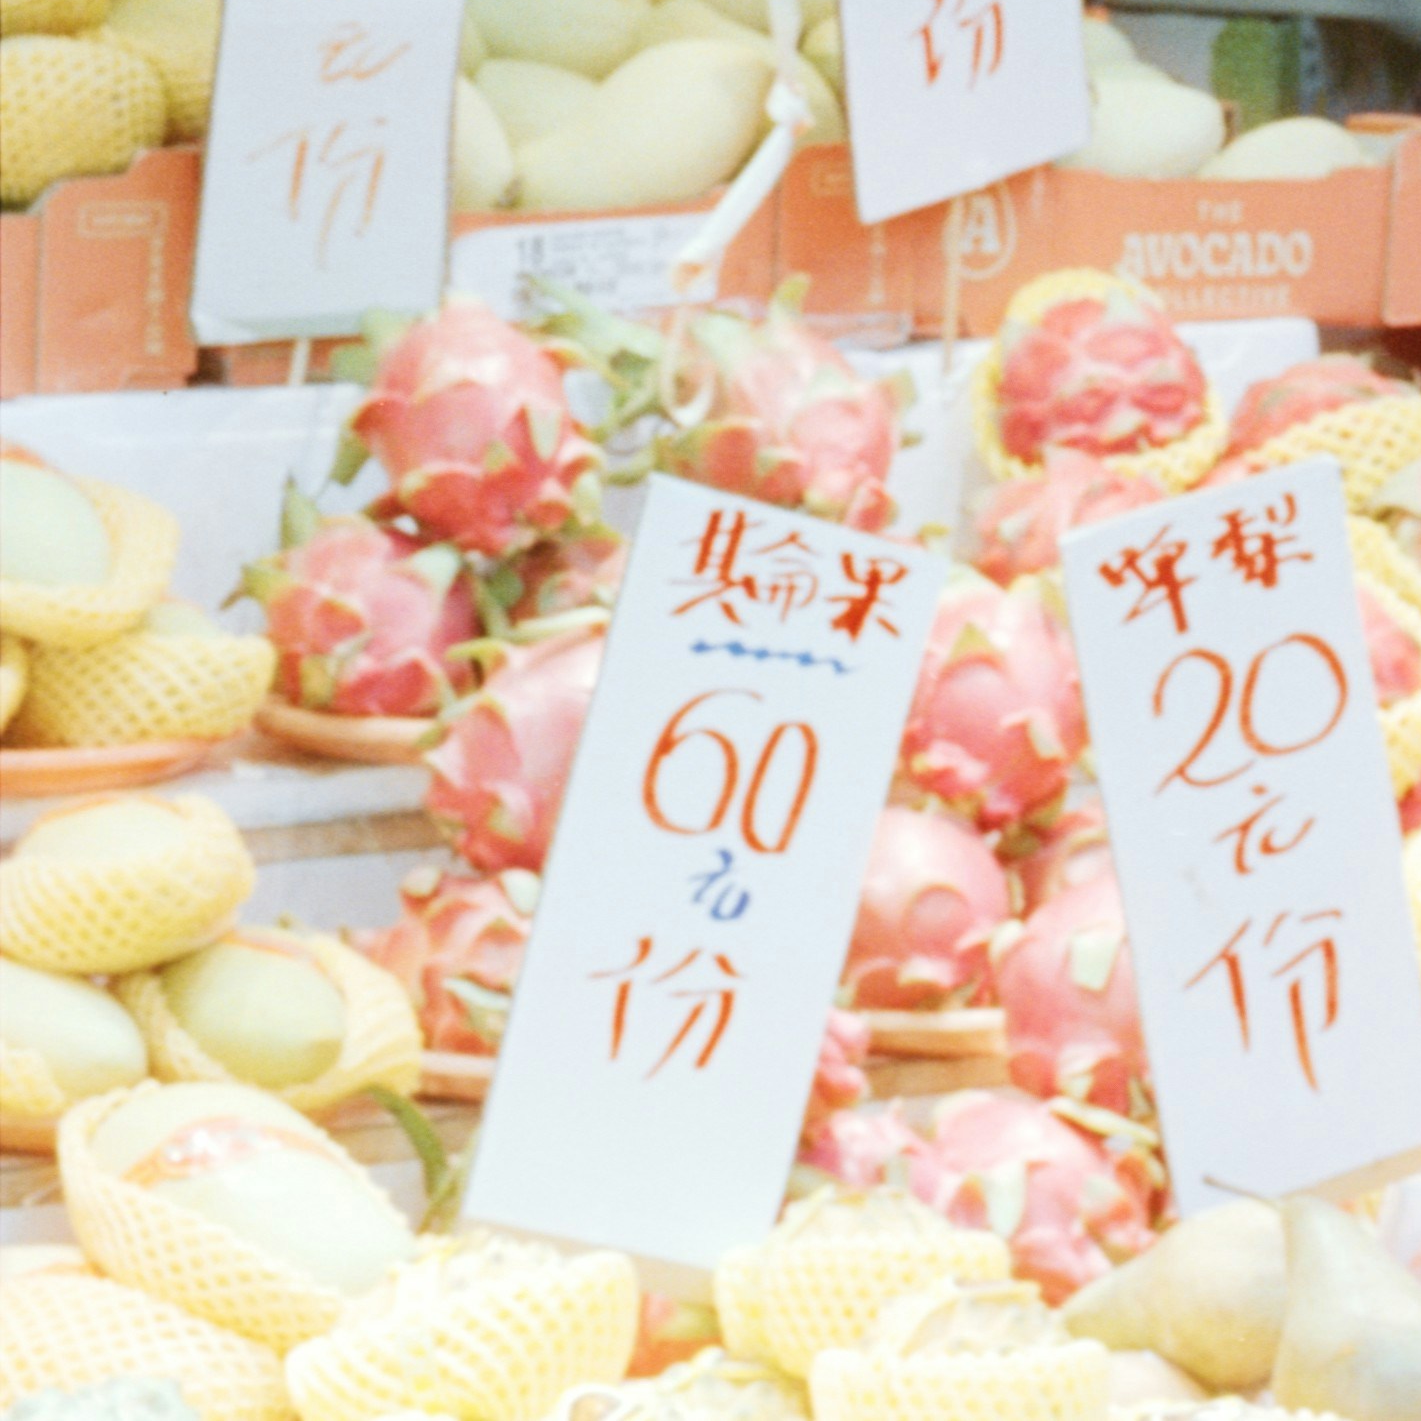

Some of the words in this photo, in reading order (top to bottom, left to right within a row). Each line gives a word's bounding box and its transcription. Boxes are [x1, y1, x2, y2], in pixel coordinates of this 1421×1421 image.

[958, 193, 1001, 254] A
[1115, 230, 1314, 279] AVOCADO
[1196, 199, 1243, 224] THE
[1150, 632, 1352, 794] 20
[641, 689, 819, 857] 60
[1213, 785, 1317, 876] 元
[588, 933, 749, 1081] 份
